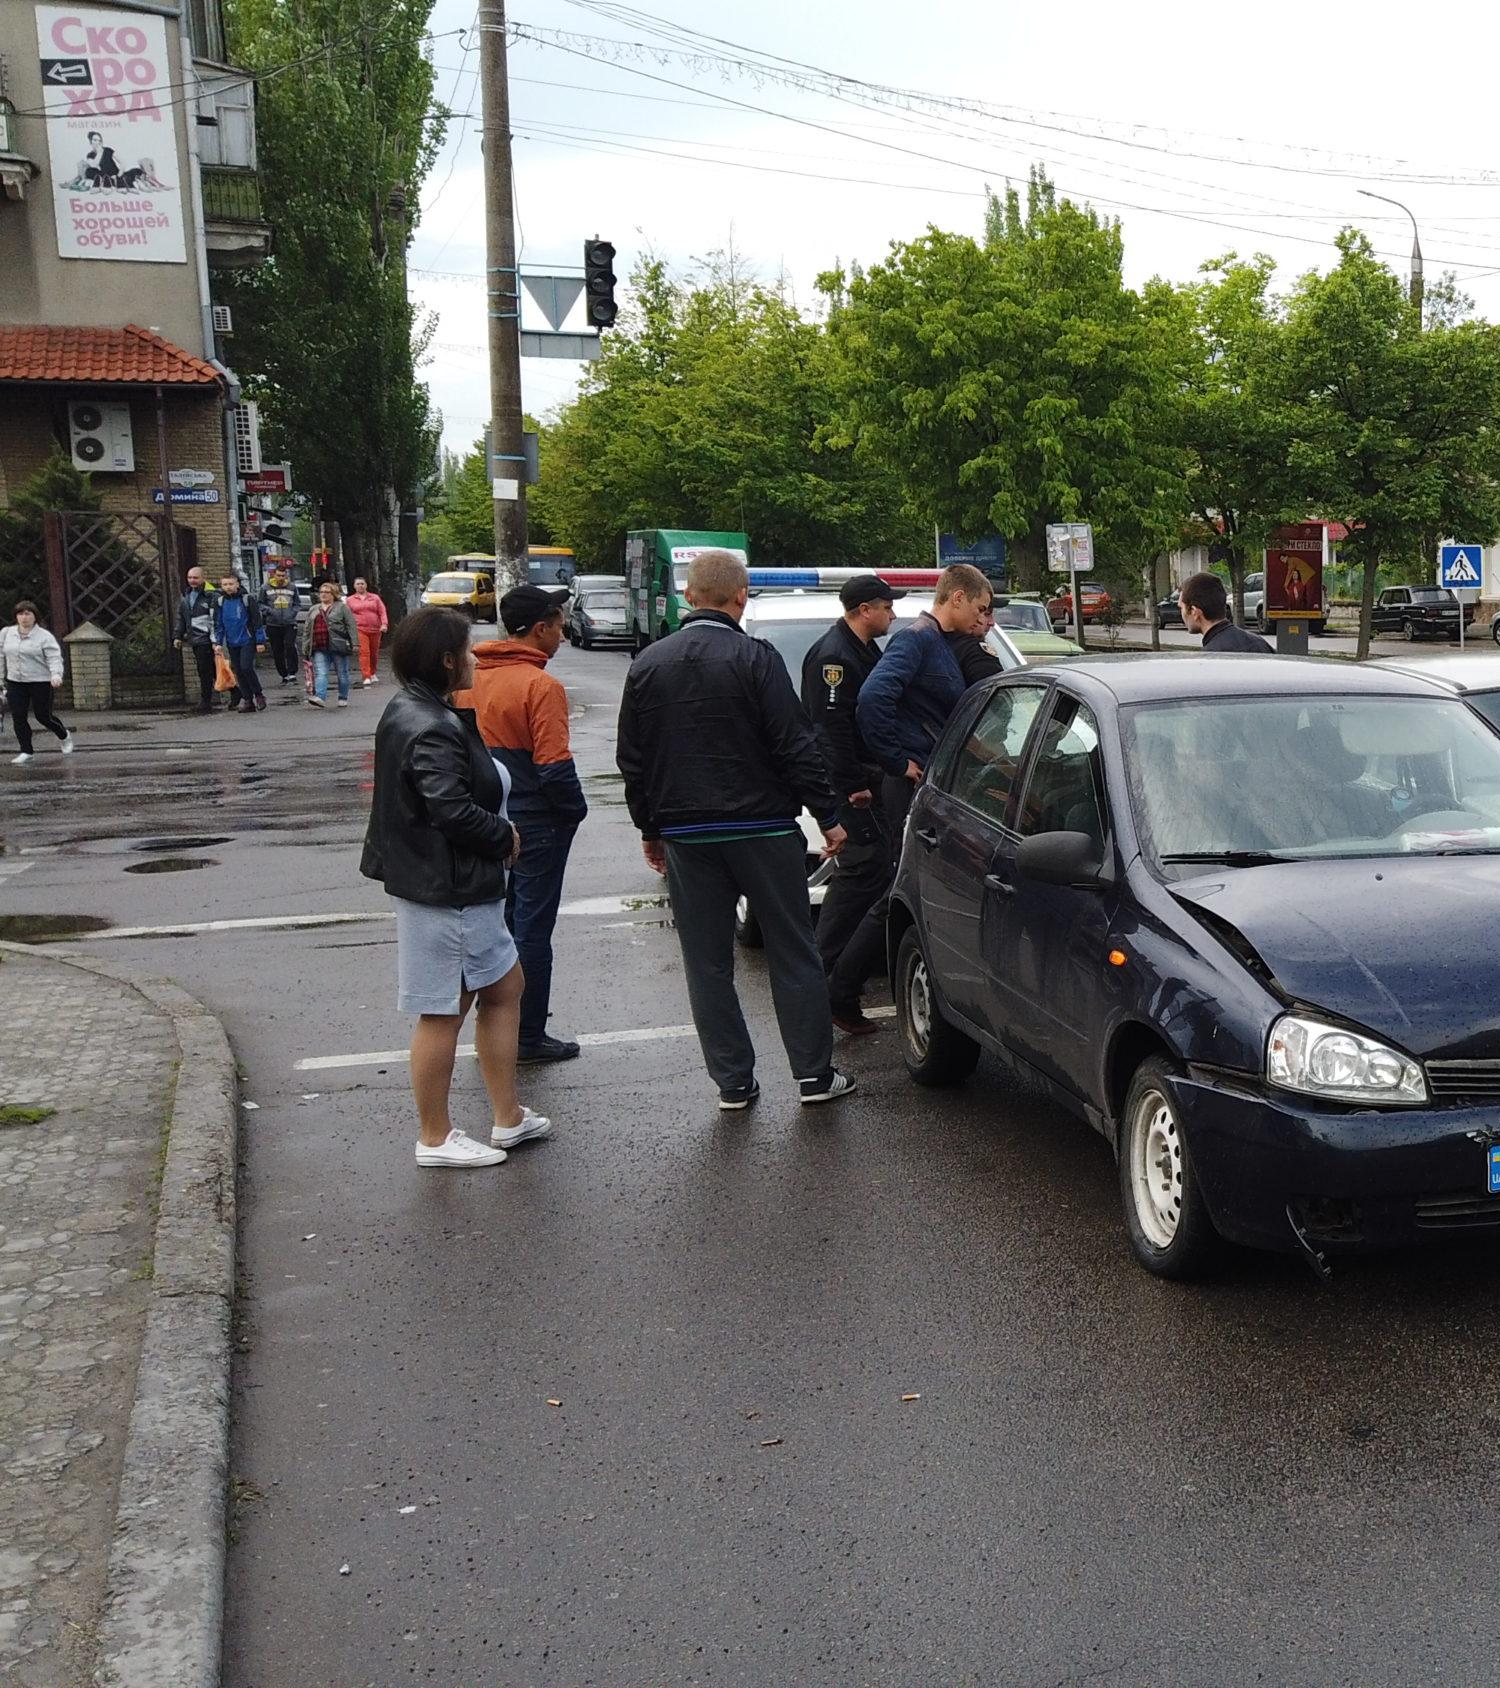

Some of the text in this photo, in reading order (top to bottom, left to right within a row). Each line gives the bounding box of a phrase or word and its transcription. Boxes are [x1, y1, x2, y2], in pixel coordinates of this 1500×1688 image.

[51, 16, 148, 55] Ско
[92, 57, 157, 93] ро
[62, 89, 162, 122] ход
[67, 120, 121, 129] магазин
[69, 197, 153, 214] Больше
[73, 212, 170, 233] хорошей
[77, 229, 148, 250] обуви!
[206, 489, 218, 501] 50
